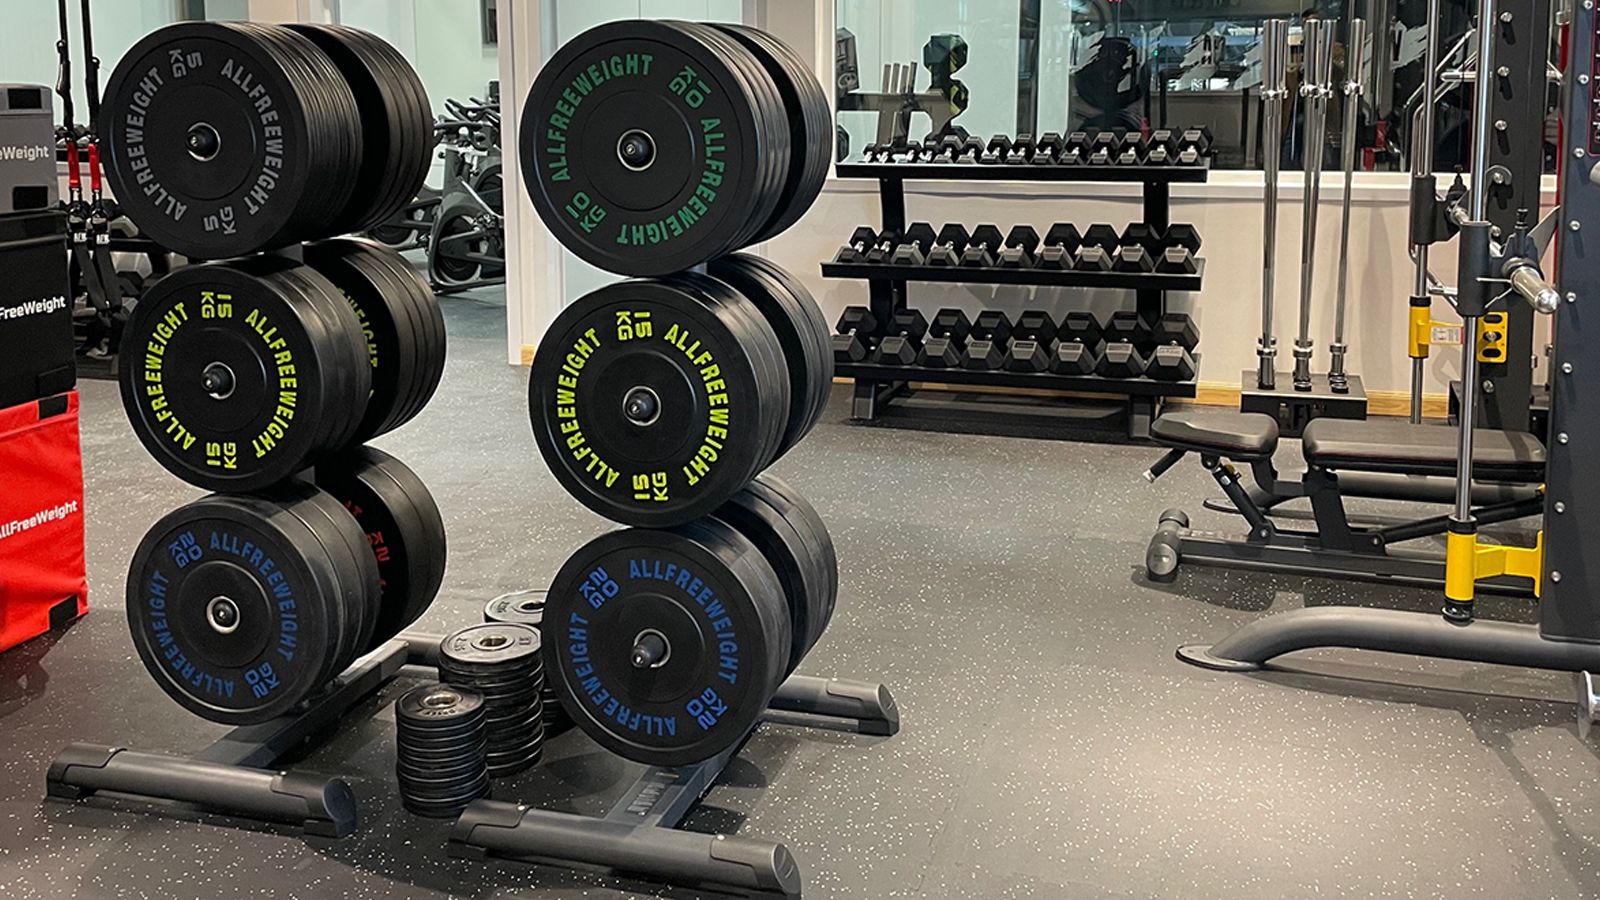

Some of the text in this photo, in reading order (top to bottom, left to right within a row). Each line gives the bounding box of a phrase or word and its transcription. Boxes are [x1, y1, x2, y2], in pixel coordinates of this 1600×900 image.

[126, 67, 187, 221] ALLFREEWEIGHT
[221, 58, 283, 215] ALLFREEWEIGHT
[547, 53, 653, 182] ALLFREEWEIGHT
[617, 117, 725, 245] ALLFREEWEIGHT
[145, 302, 196, 450] ALLFREEWEIGHT
[244, 308, 298, 458] ALLFREEWEIGHT
[557, 328, 620, 488] ALLFREEWEIGHT
[664, 323, 729, 486] ALLFREEWEIGHT
[149, 570, 235, 698] ALLFREEWEIGHT
[208, 531, 298, 662] ALLFREEWEIGHT
[629, 559, 738, 685] ALLFREEWEIGHT
[569, 612, 676, 737] ALLFREEWEIGHT
